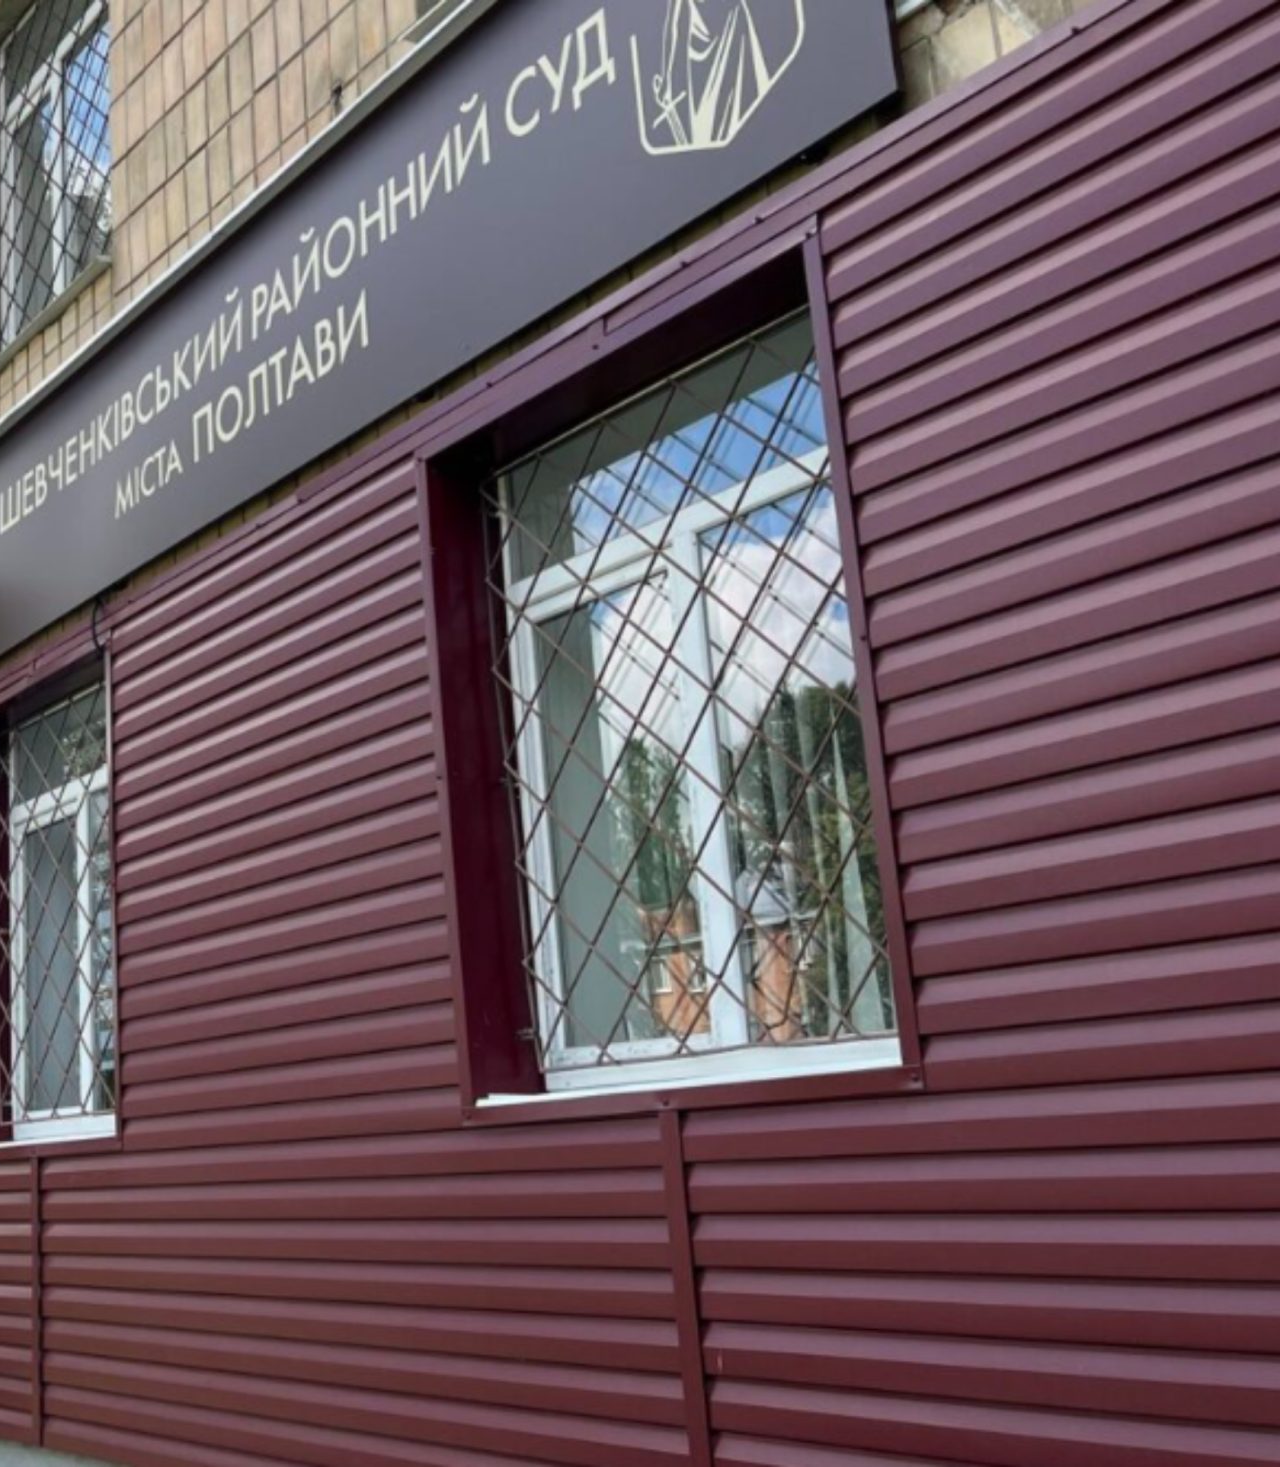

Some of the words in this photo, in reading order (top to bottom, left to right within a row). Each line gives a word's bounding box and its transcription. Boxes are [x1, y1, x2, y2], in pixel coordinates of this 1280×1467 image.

[250, 92, 491, 342] РАЙОННИЙ
[504, 7, 617, 138] СУД
[114, 439, 184, 520] МІСТА
[191, 289, 369, 463] ПОЛТАВИ
